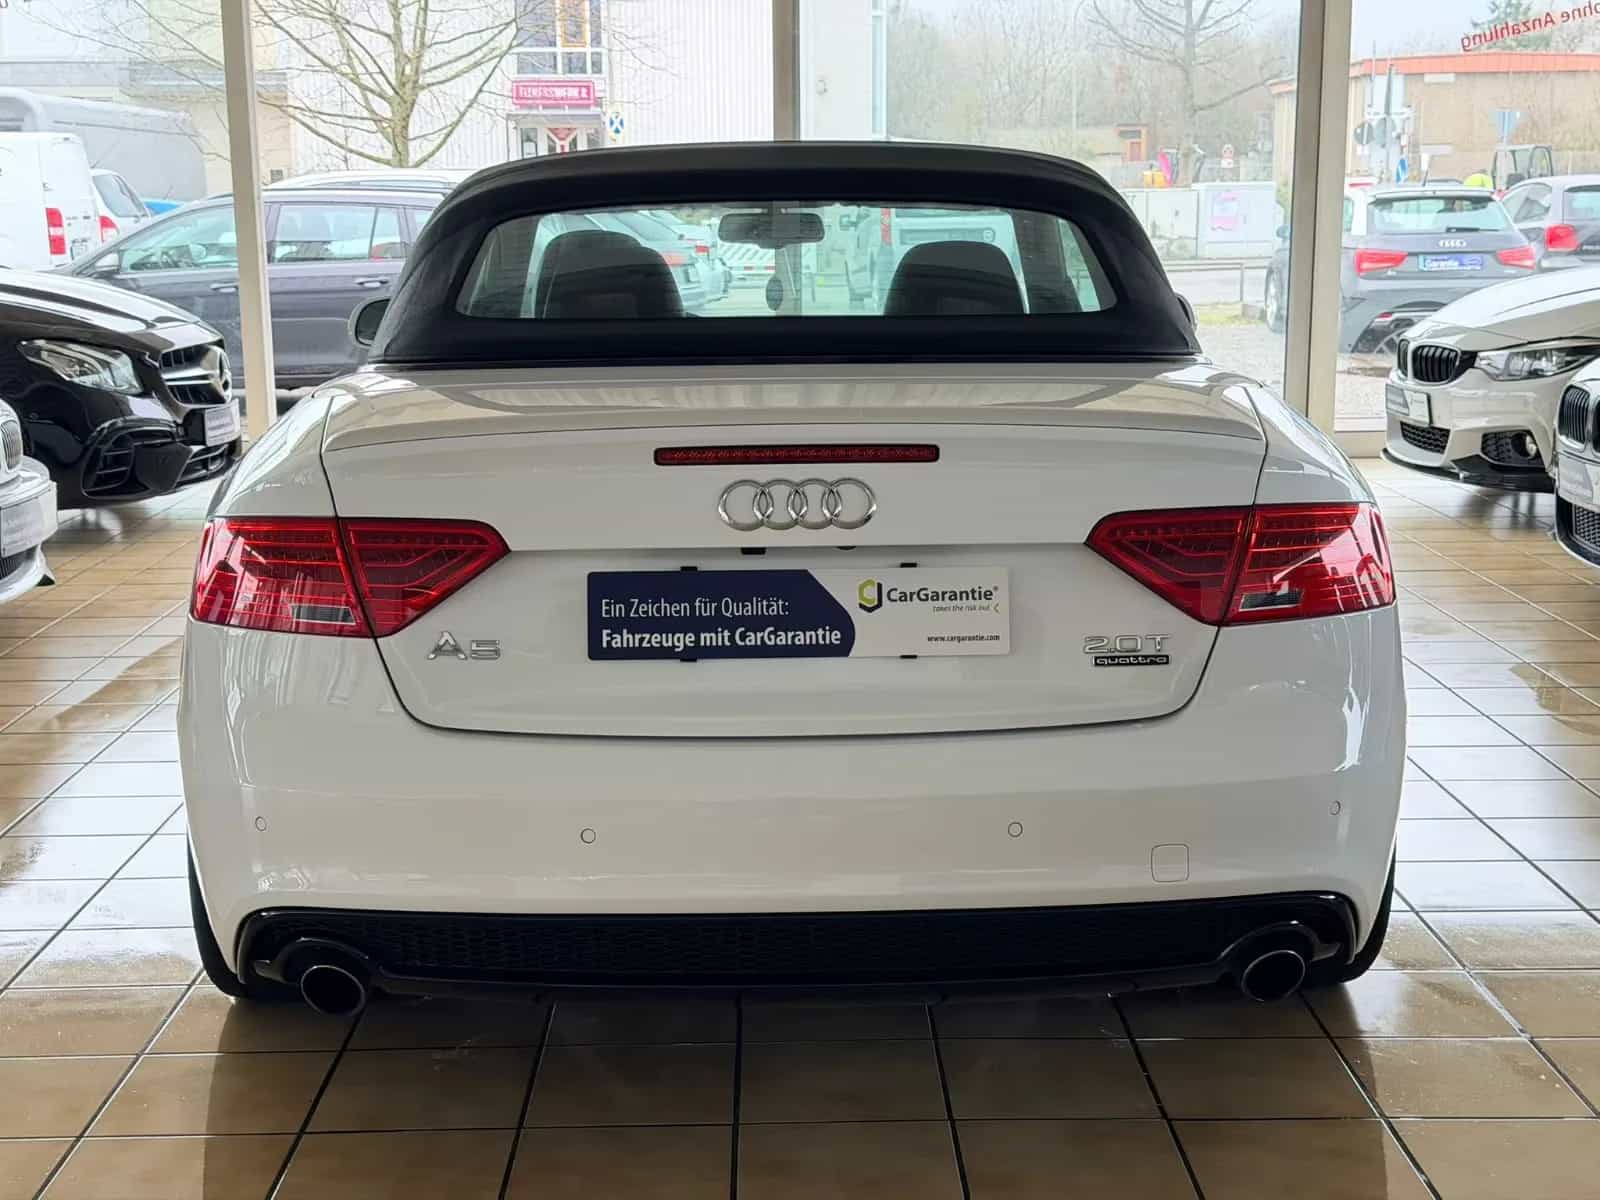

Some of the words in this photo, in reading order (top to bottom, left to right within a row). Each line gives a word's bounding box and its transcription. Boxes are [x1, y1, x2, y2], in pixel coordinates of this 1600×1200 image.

[601, 599, 625, 617] Ein
[630, 598, 690, 617] Zeichen
[695, 598, 717, 616] für
[721, 597, 789, 617] Qualität:
[427, 630, 501, 660] A5
[602, 629, 695, 651] Fahrzeuge
[700, 628, 730, 646] mit
[735, 626, 841, 645] CarGarantie
[927, 632, 1000, 643] www.cargarantie.com
[1095, 656, 1167, 665] quattro
